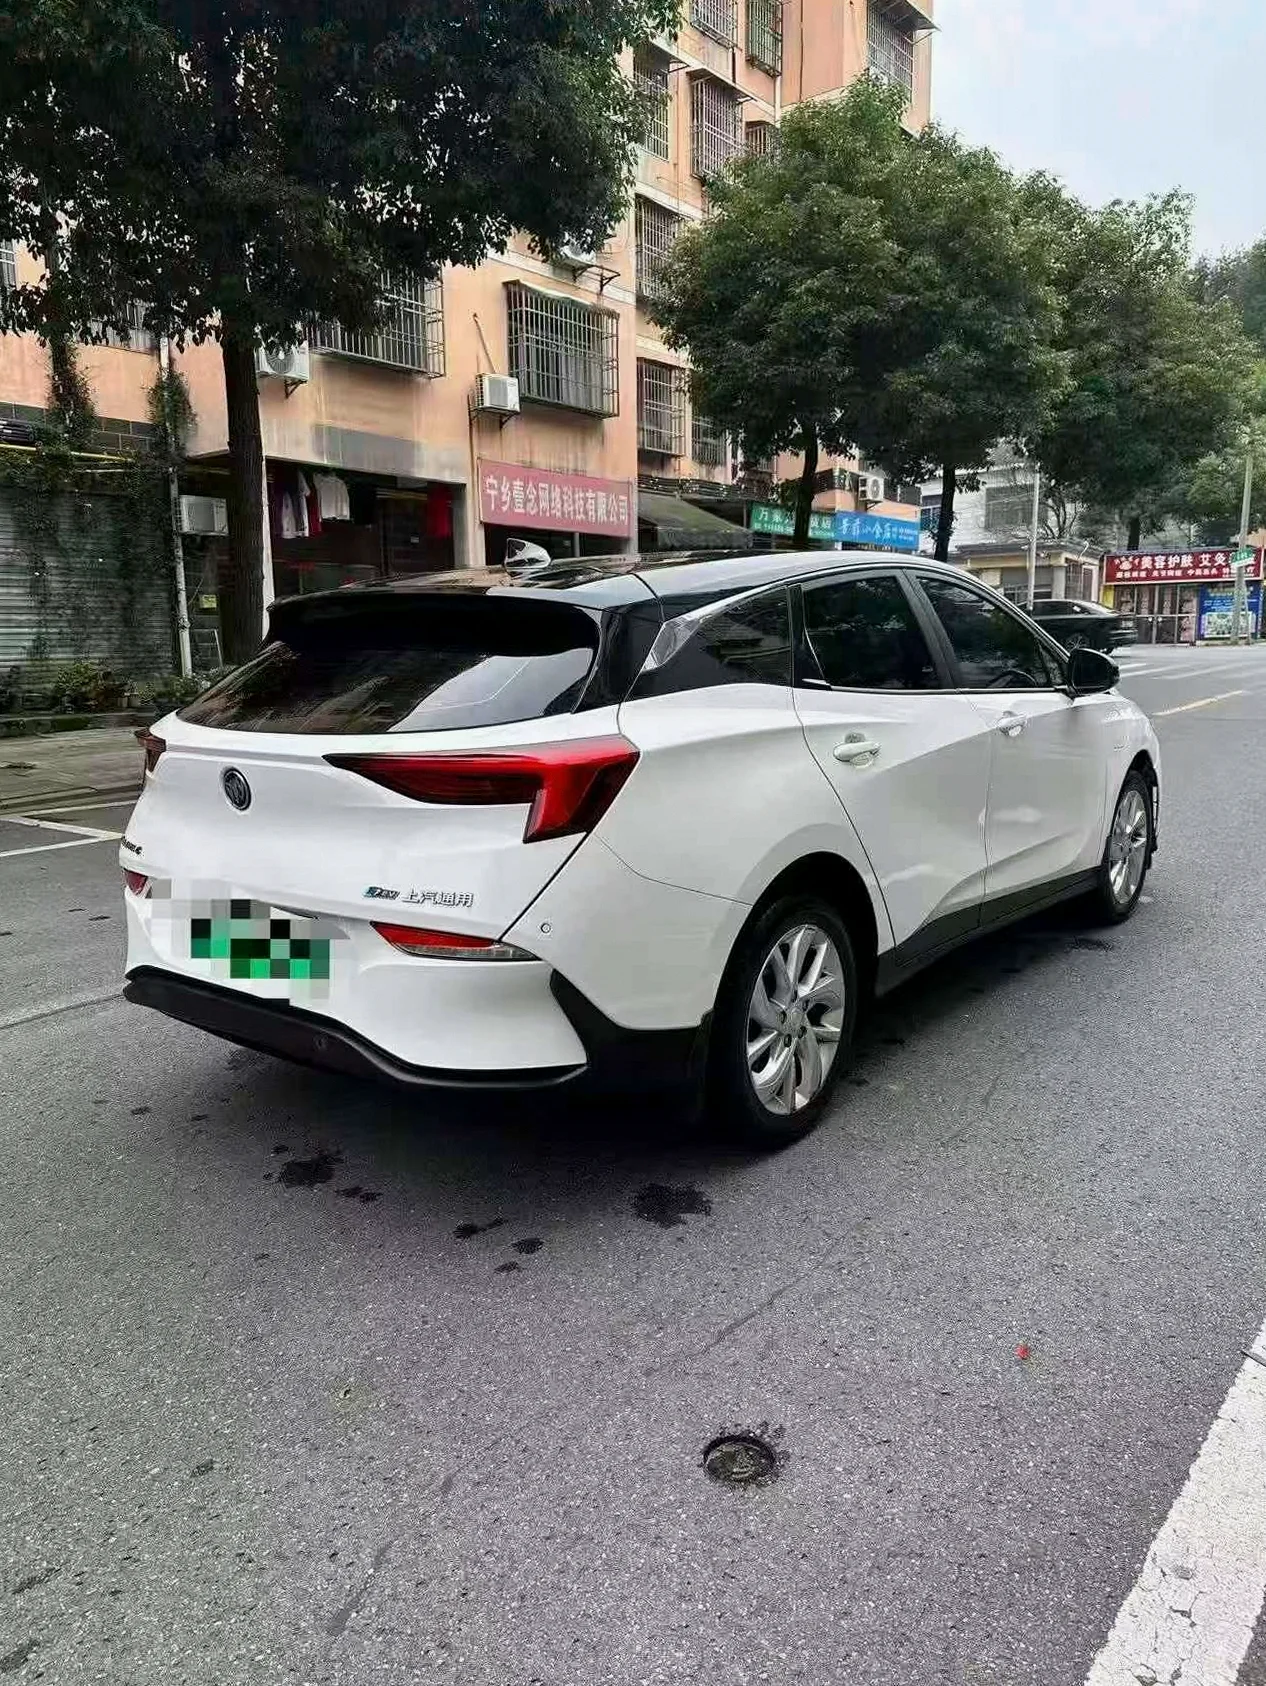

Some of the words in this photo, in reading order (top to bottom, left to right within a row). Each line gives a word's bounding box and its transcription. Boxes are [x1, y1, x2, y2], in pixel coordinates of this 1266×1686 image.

[485, 474, 628, 526] 宁乡壹念网络科技有限公司
[1140, 554, 1194, 570] 美容护肤
[401, 887, 475, 908] 上汽通用
